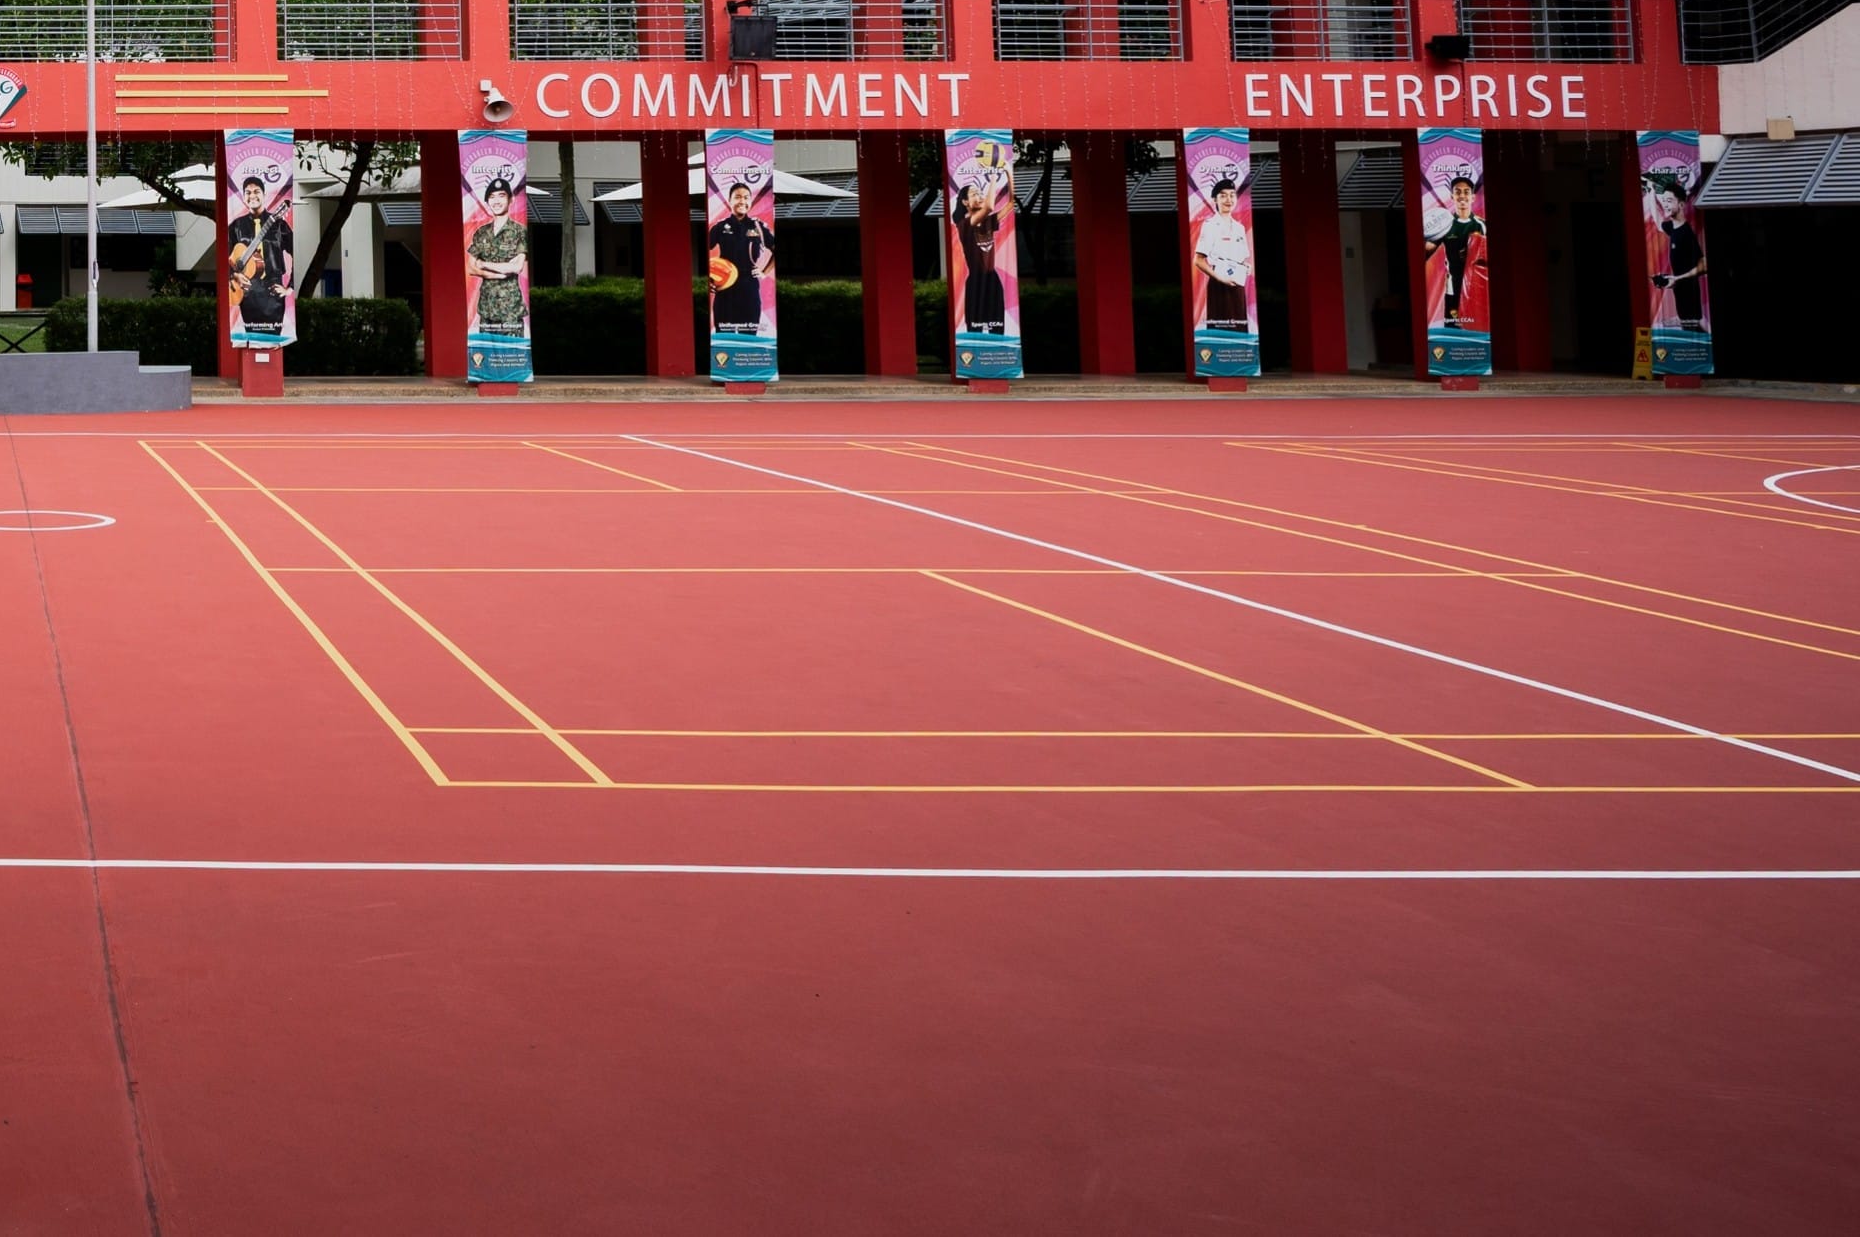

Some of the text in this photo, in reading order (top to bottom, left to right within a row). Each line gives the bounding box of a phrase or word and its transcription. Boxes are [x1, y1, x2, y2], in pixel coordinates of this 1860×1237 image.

[536, 73, 969, 118] COMMITMENT
[1245, 74, 1587, 119] ENTERPRISE
[710, 166, 770, 174] Commitment
[957, 167, 1004, 175] Enterprise
[1200, 166, 1238, 174] Dynamic
[1433, 164, 1471, 174] Thinking
[1650, 167, 1691, 175] Character
